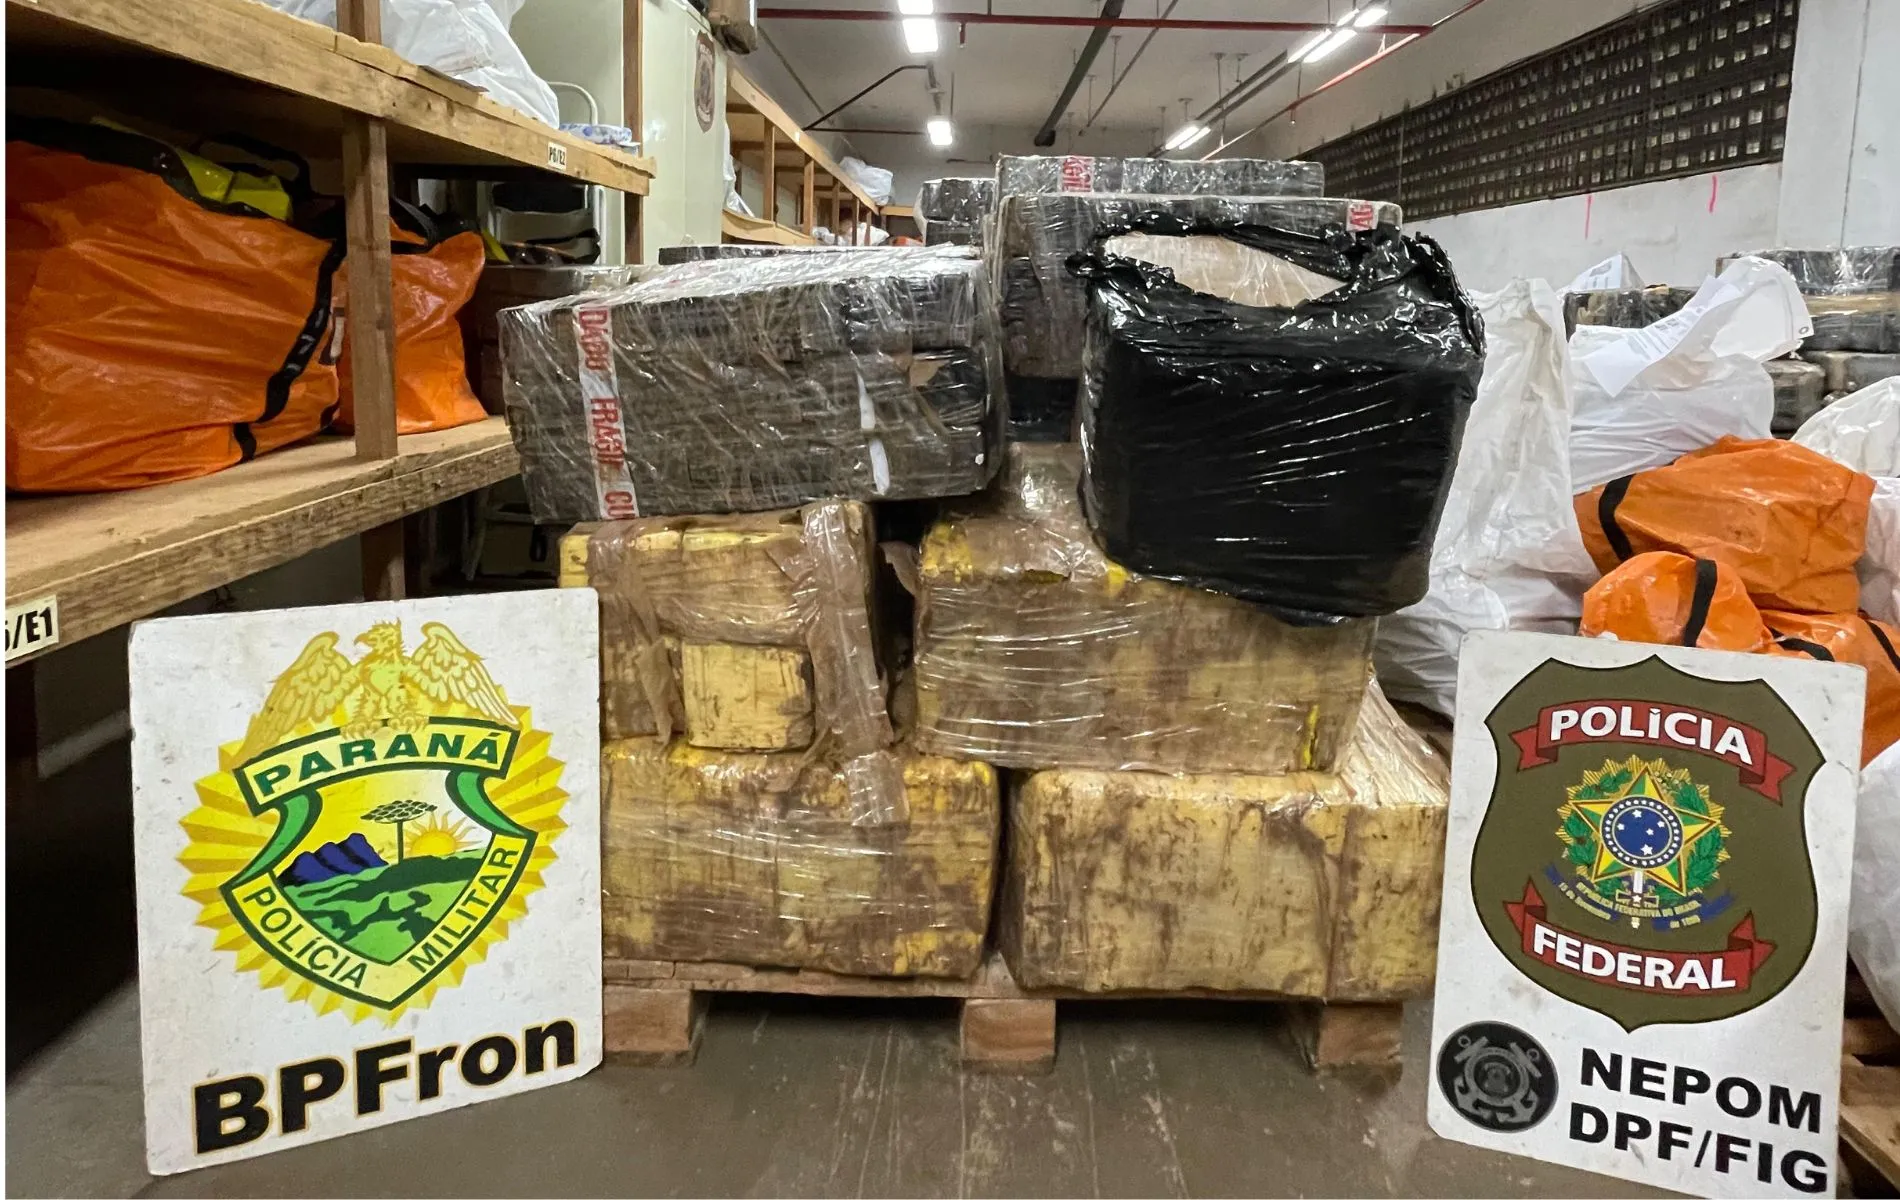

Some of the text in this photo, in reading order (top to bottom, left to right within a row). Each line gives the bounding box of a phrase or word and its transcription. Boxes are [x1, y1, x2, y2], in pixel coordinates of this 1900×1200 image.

[253, 732, 501, 797] PARANÁ
[1550, 706, 1753, 765] POLÍCIA
[242, 847, 518, 989] POLÍCIA MILITAR
[1533, 923, 1736, 990] FEDERAL
[193, 1018, 578, 1155] BPFron
[1581, 1047, 1821, 1134] NEPOM
[1569, 1102, 1828, 1193] DPF/FIG
